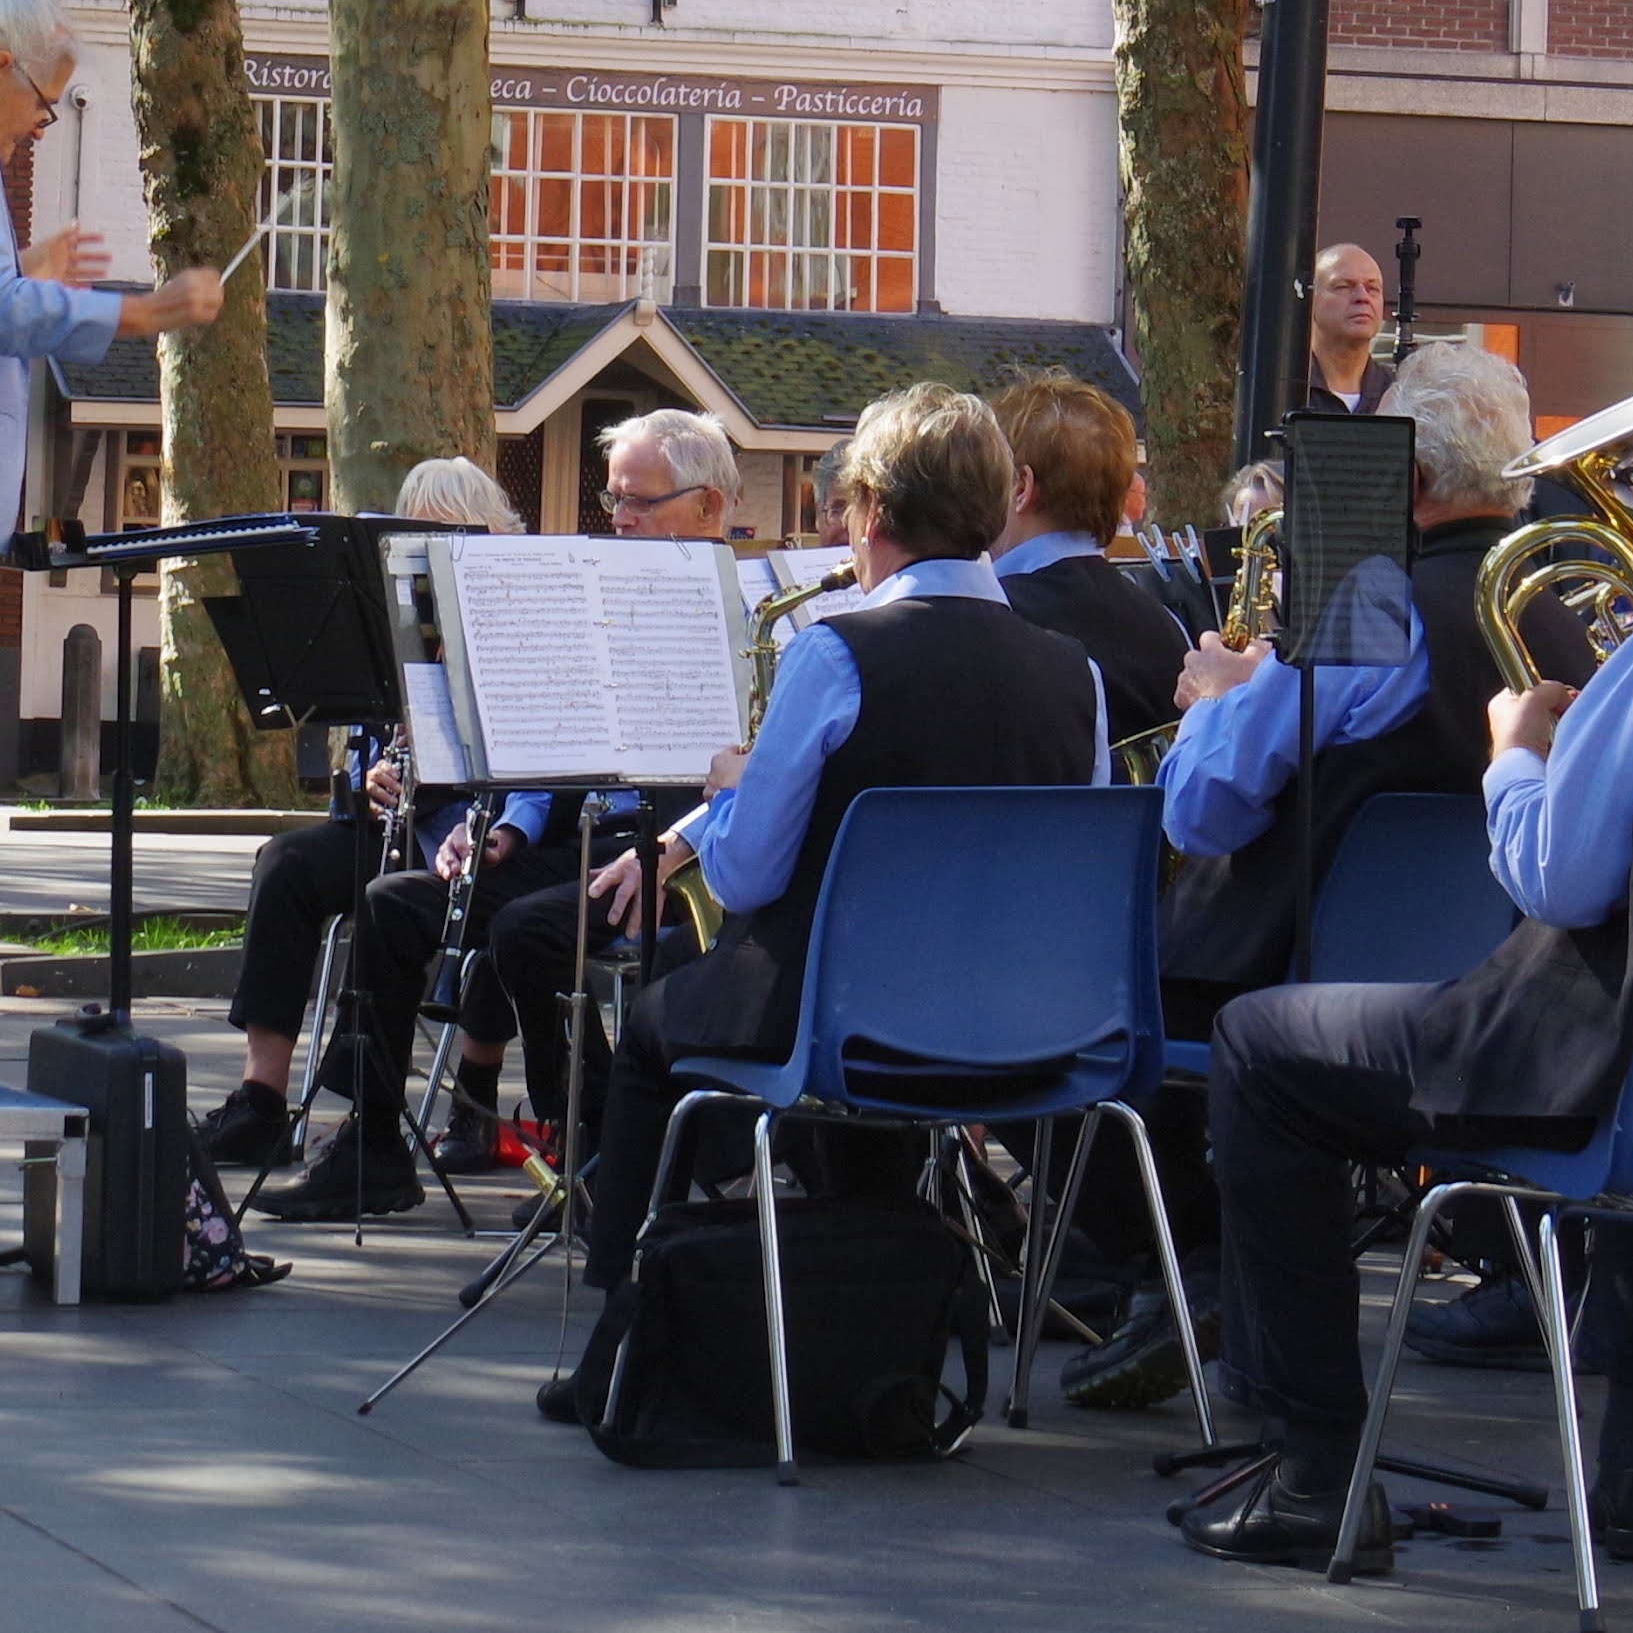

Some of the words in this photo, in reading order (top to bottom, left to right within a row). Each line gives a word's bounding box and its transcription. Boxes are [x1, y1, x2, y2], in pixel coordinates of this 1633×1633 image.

[489, 78, 533, 100] eca
[566, 75, 743, 109] Cioccolateria
[773, 84, 924, 118] Pasticceria
